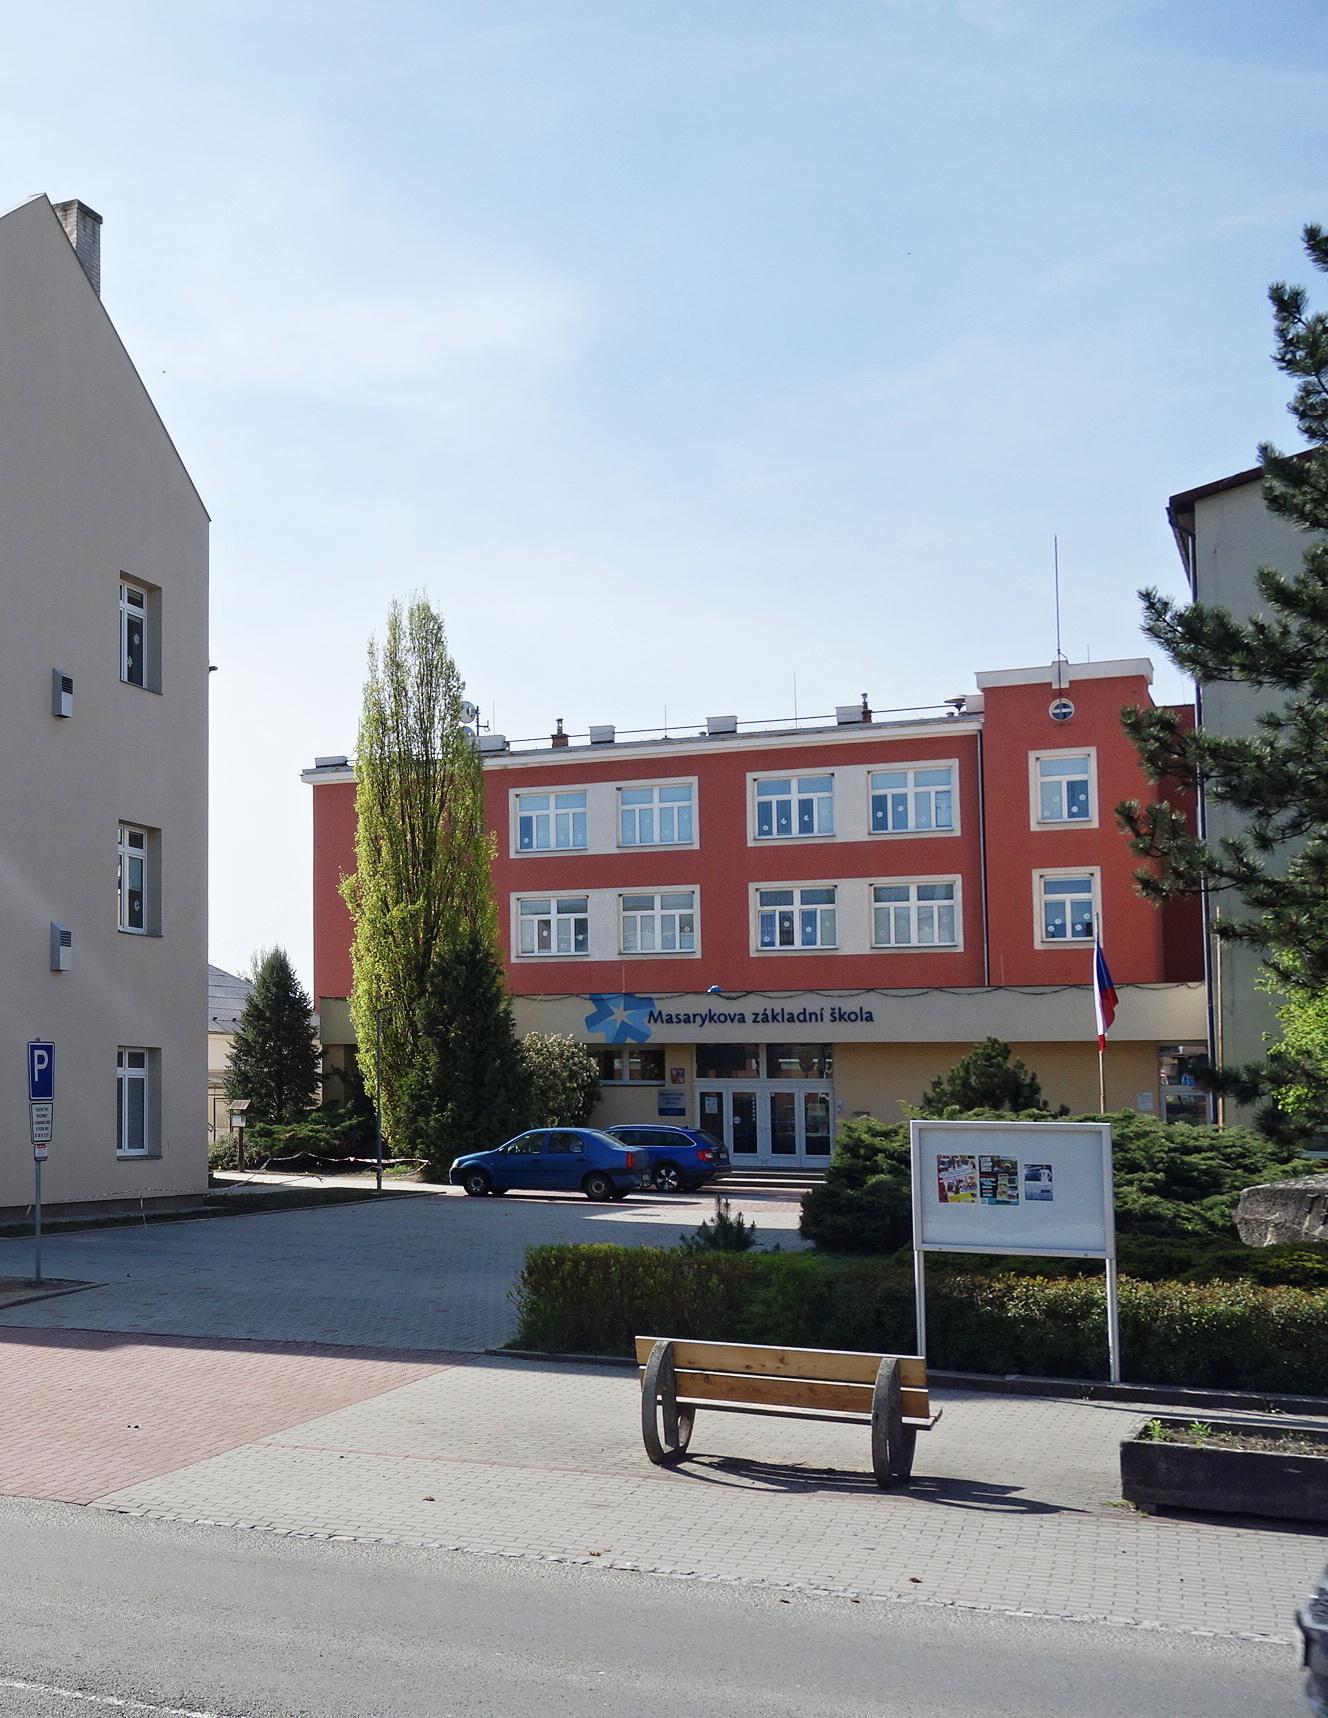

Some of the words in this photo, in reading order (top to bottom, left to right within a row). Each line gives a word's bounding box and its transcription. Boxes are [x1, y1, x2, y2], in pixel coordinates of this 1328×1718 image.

[647, 1009, 746, 1027] Masarykova
[752, 1007, 824, 1023] základní
[829, 1006, 874, 1022] škola
[34, 1049, 49, 1082] P
